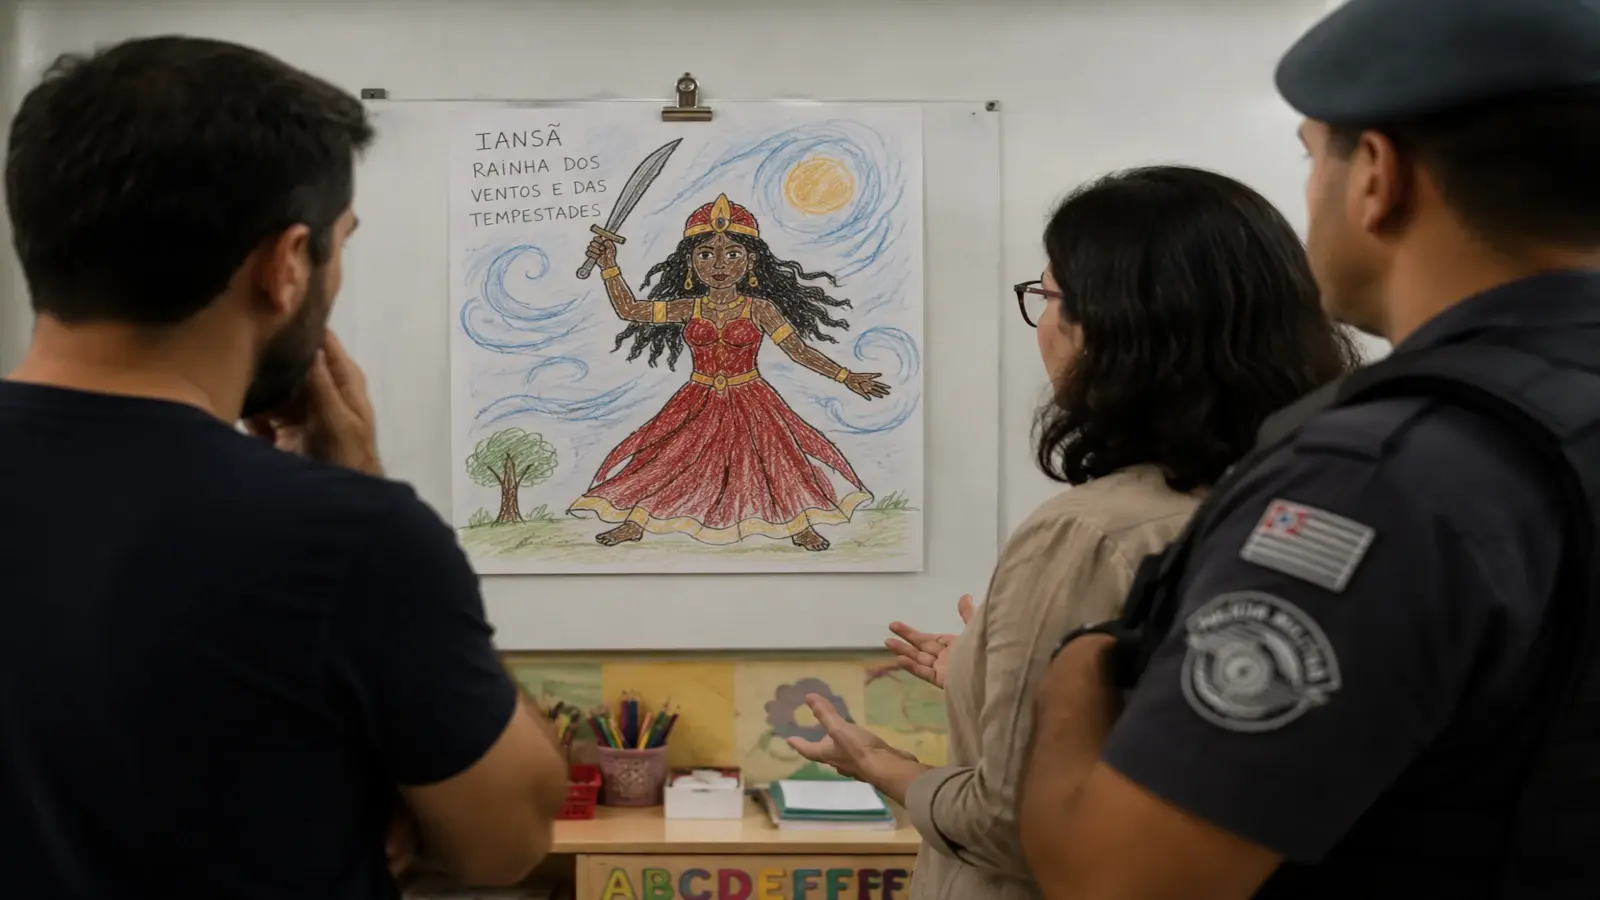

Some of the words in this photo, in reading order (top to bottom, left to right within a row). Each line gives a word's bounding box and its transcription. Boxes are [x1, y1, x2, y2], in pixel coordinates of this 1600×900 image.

[475, 122, 562, 151] IANSÃ
[564, 155, 600, 172] DOS
[471, 184, 541, 203] VENTOS
[552, 182, 563, 196] E
[573, 179, 607, 195] DAS
[469, 203, 601, 227] TEMPESTADES
